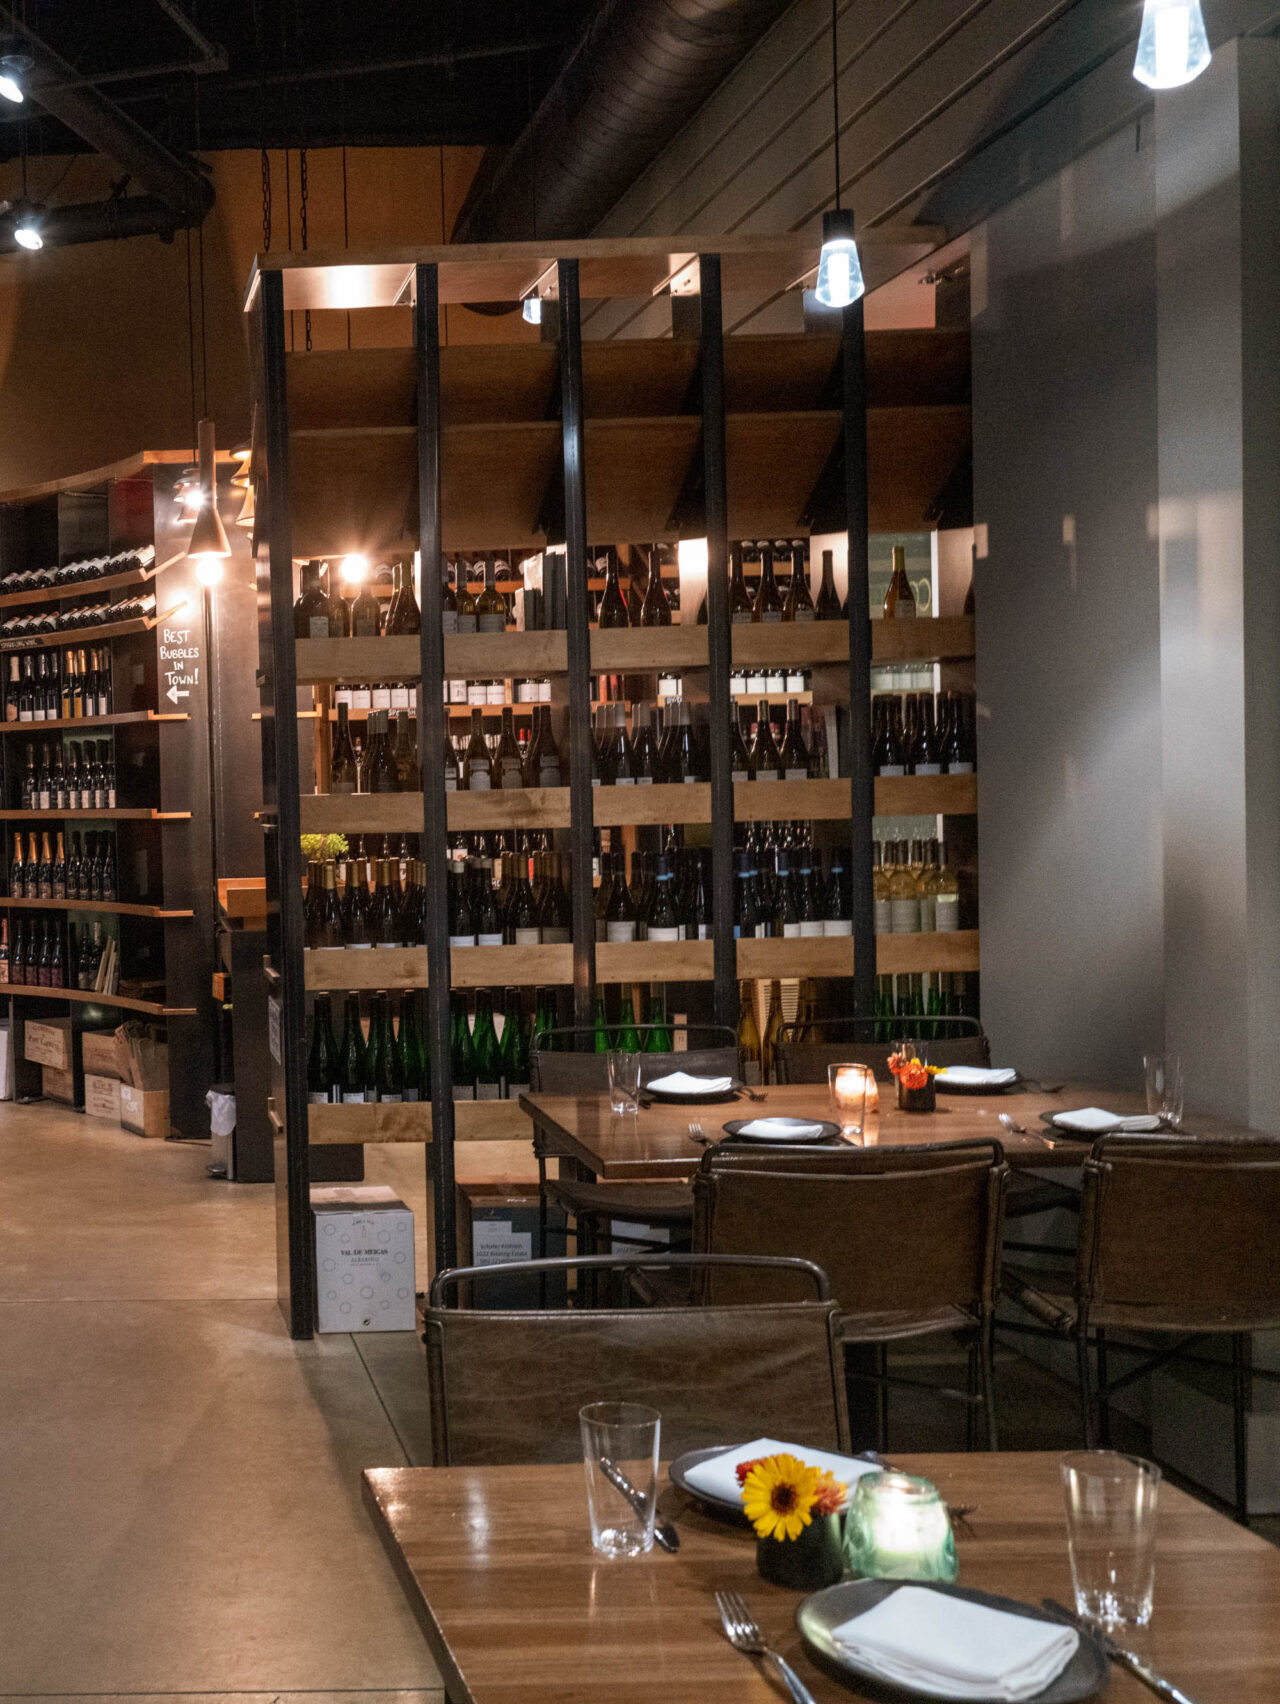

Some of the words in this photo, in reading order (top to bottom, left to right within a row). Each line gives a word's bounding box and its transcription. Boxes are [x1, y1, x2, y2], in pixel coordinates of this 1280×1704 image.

[163, 628, 190, 644] BEST
[160, 646, 199, 660] BUBBLES
[173, 661, 184, 671] IN
[164, 668, 199, 686] TOWN!
